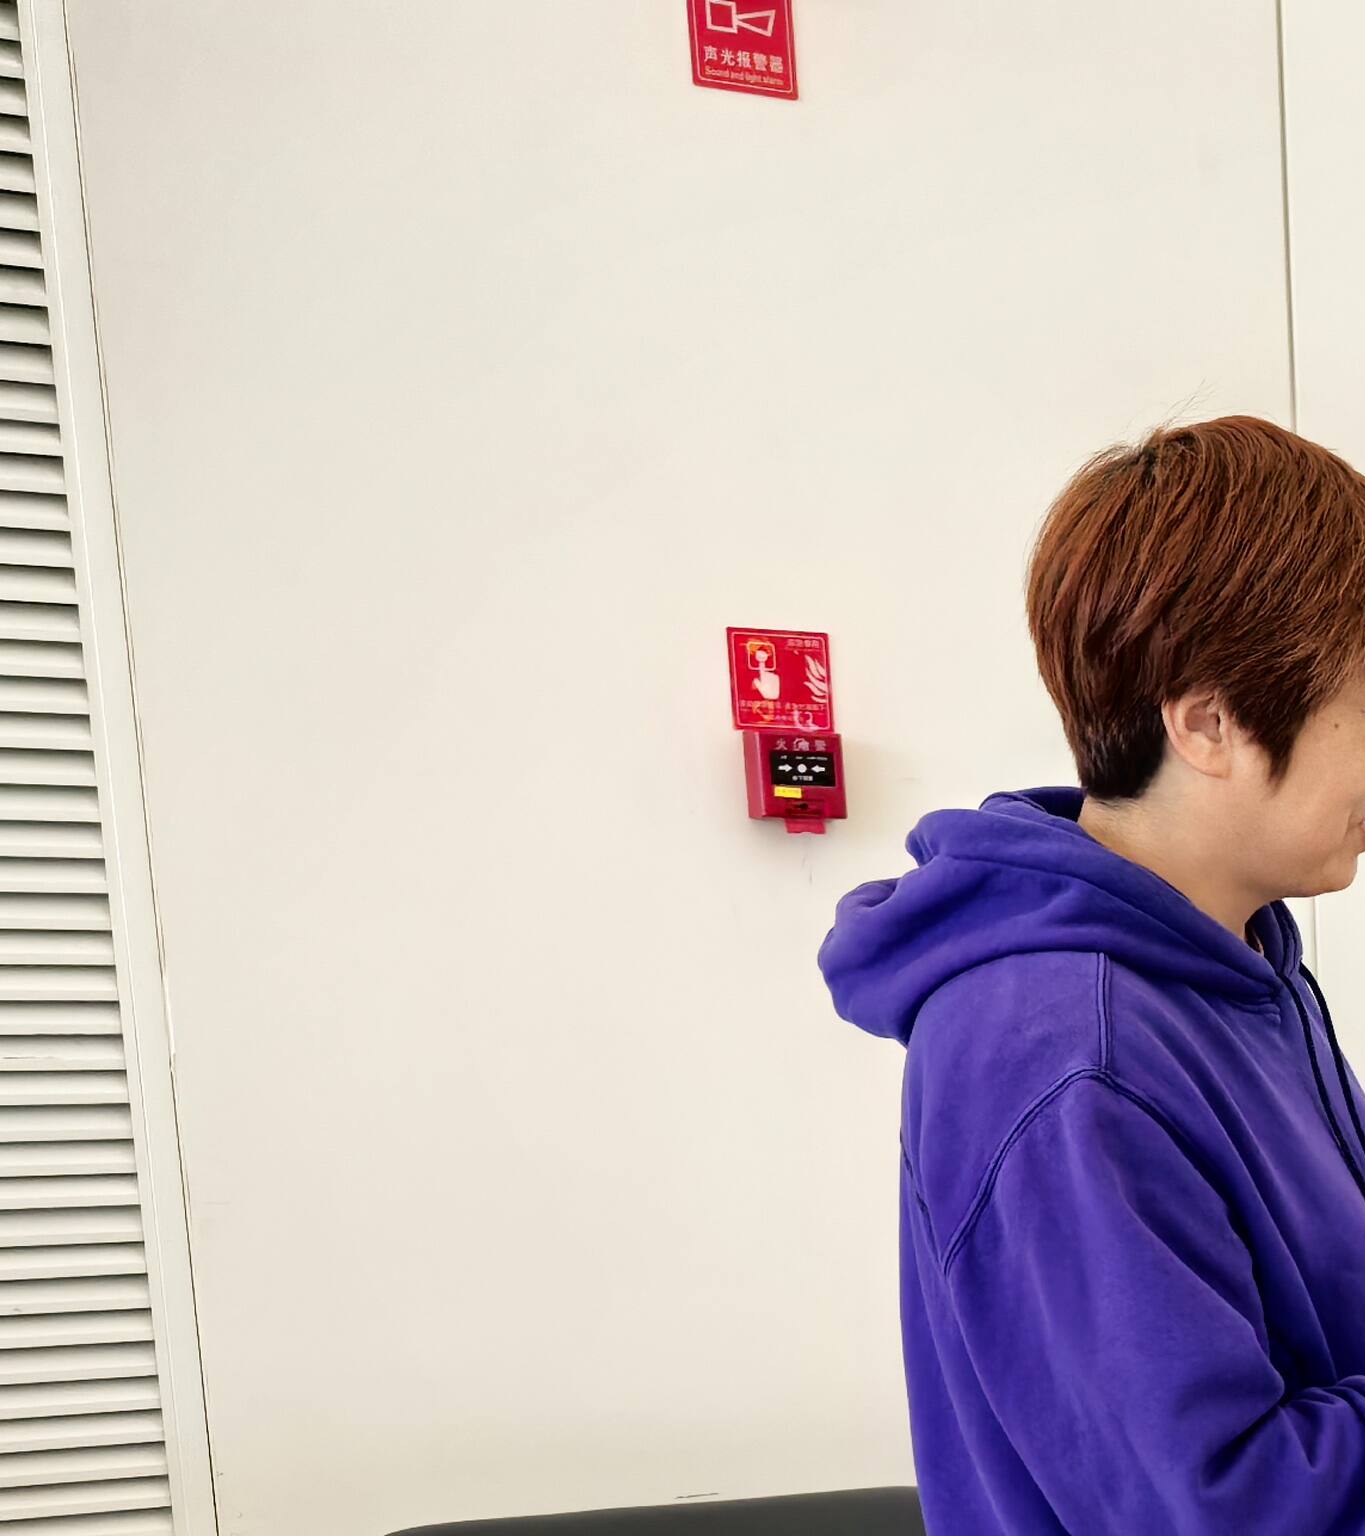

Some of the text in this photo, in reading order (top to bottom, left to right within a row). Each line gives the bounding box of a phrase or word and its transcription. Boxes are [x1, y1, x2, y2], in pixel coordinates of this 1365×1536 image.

[703, 45, 784, 74] 声光报警器
